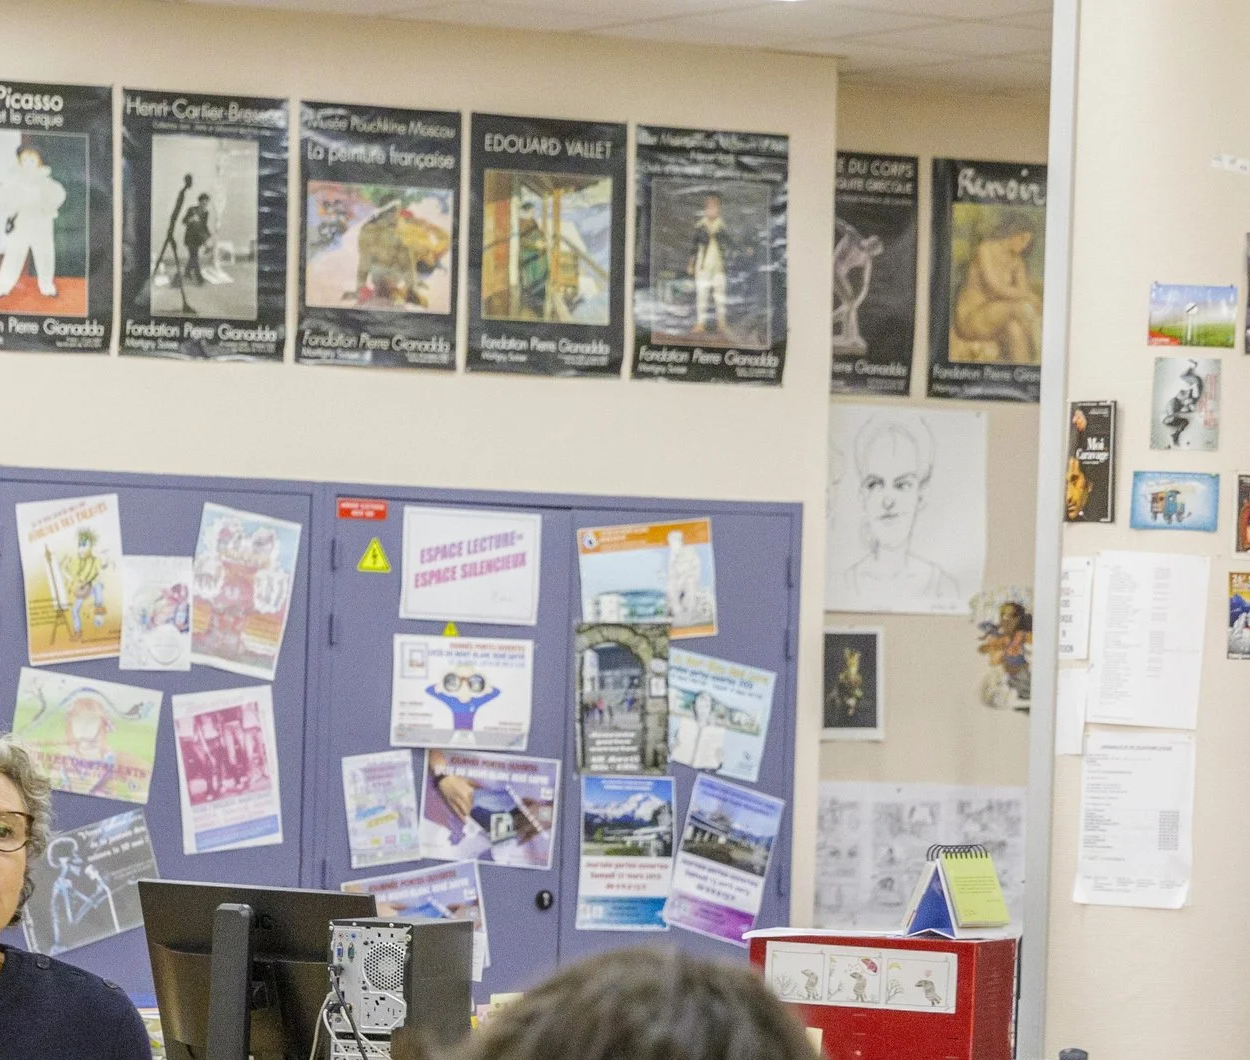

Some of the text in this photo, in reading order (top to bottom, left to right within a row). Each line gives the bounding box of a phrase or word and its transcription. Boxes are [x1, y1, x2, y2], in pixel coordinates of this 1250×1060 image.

[125, 95, 168, 118] Henri
[25, 113, 64, 130] cirque
[484, 133, 611, 160] EDOUARD VALLET
[8, 316, 39, 335] Pierre
[43, 317, 105, 336] Gianadda
[125, 319, 277, 342] Fondation Pierre Gianadda
[302, 329, 450, 353] Fondation Pierre Gianadda
[481, 333, 529, 351] Fondation
[530, 336, 557, 353] Pierre
[639, 345, 690, 364] Fondation
[692, 348, 722, 365] Pierre
[419, 541, 464, 565] ESPACE
[414, 552, 527, 589] ESPACE SILENCIEUX
